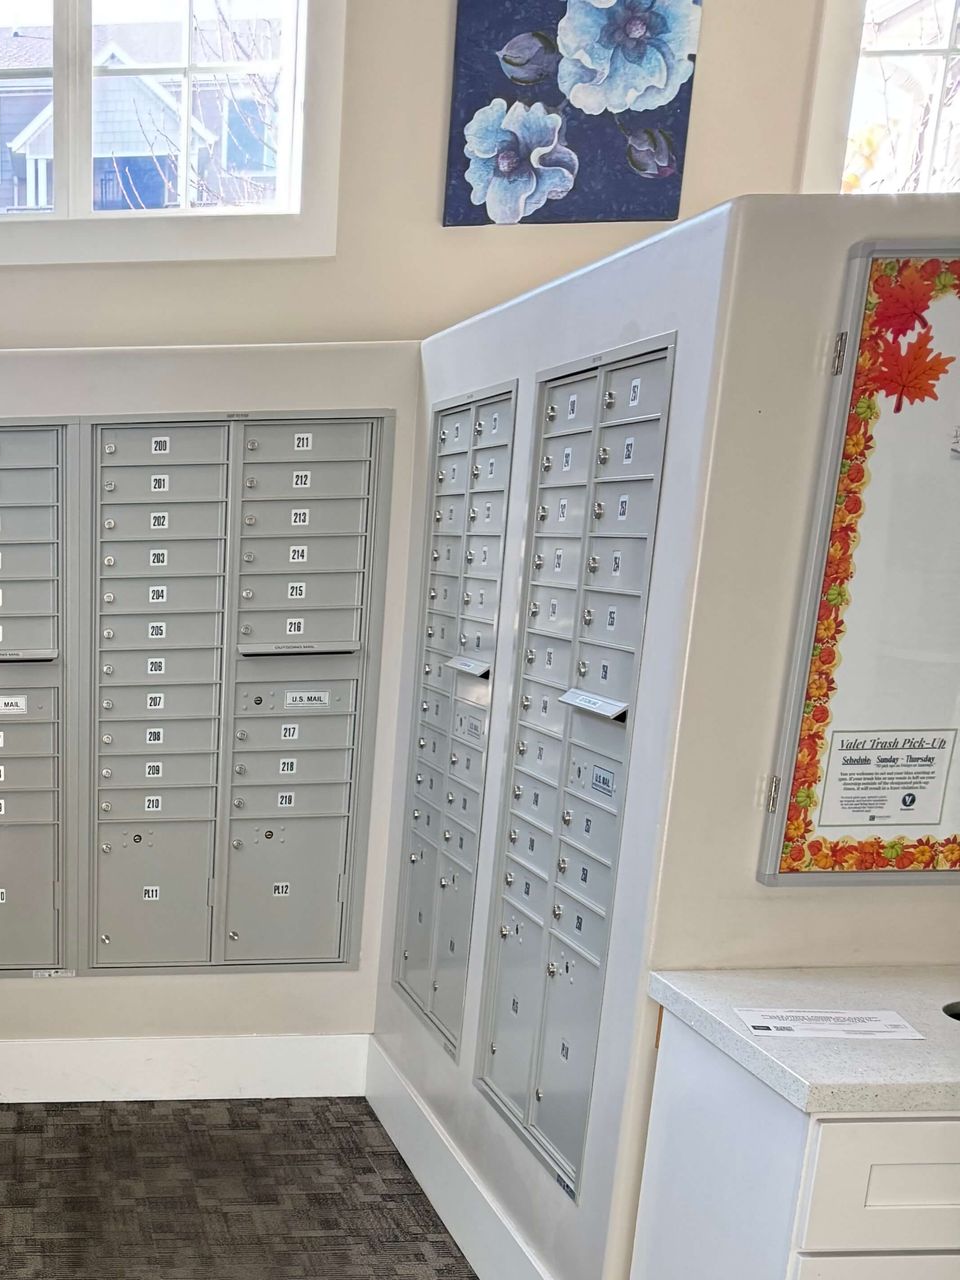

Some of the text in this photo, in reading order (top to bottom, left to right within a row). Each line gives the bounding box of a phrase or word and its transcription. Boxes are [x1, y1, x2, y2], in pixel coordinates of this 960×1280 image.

[154, 440, 167, 452] 200
[296, 436, 309, 448] 211
[153, 478, 166, 490] 201
[294, 474, 308, 486] 212
[152, 515, 166, 527] 202
[293, 512, 307, 524] 213
[152, 552, 165, 564] 203
[291, 549, 305, 560] 214
[151, 589, 164, 600] 204
[290, 585, 303, 597] 215
[150, 625, 164, 636] 205
[288, 621, 302, 633] 216
[150, 661, 163, 672] 206
[149, 696, 162, 707] 207
[292, 695, 305, 703] U.S.
[148, 731, 161, 742] 208
[283, 726, 296, 738] 217
[840, 737, 947, 750] Valet Trash Pick-Up
[876, 755, 899, 765] Sunday
[906, 754, 935, 764] Thursday
[147, 764, 160, 776] 209
[281, 761, 294, 772] 218
[146, 798, 160, 809] 210
[143, 888, 158, 899] PL11
[273, 884, 289, 895] PL12
